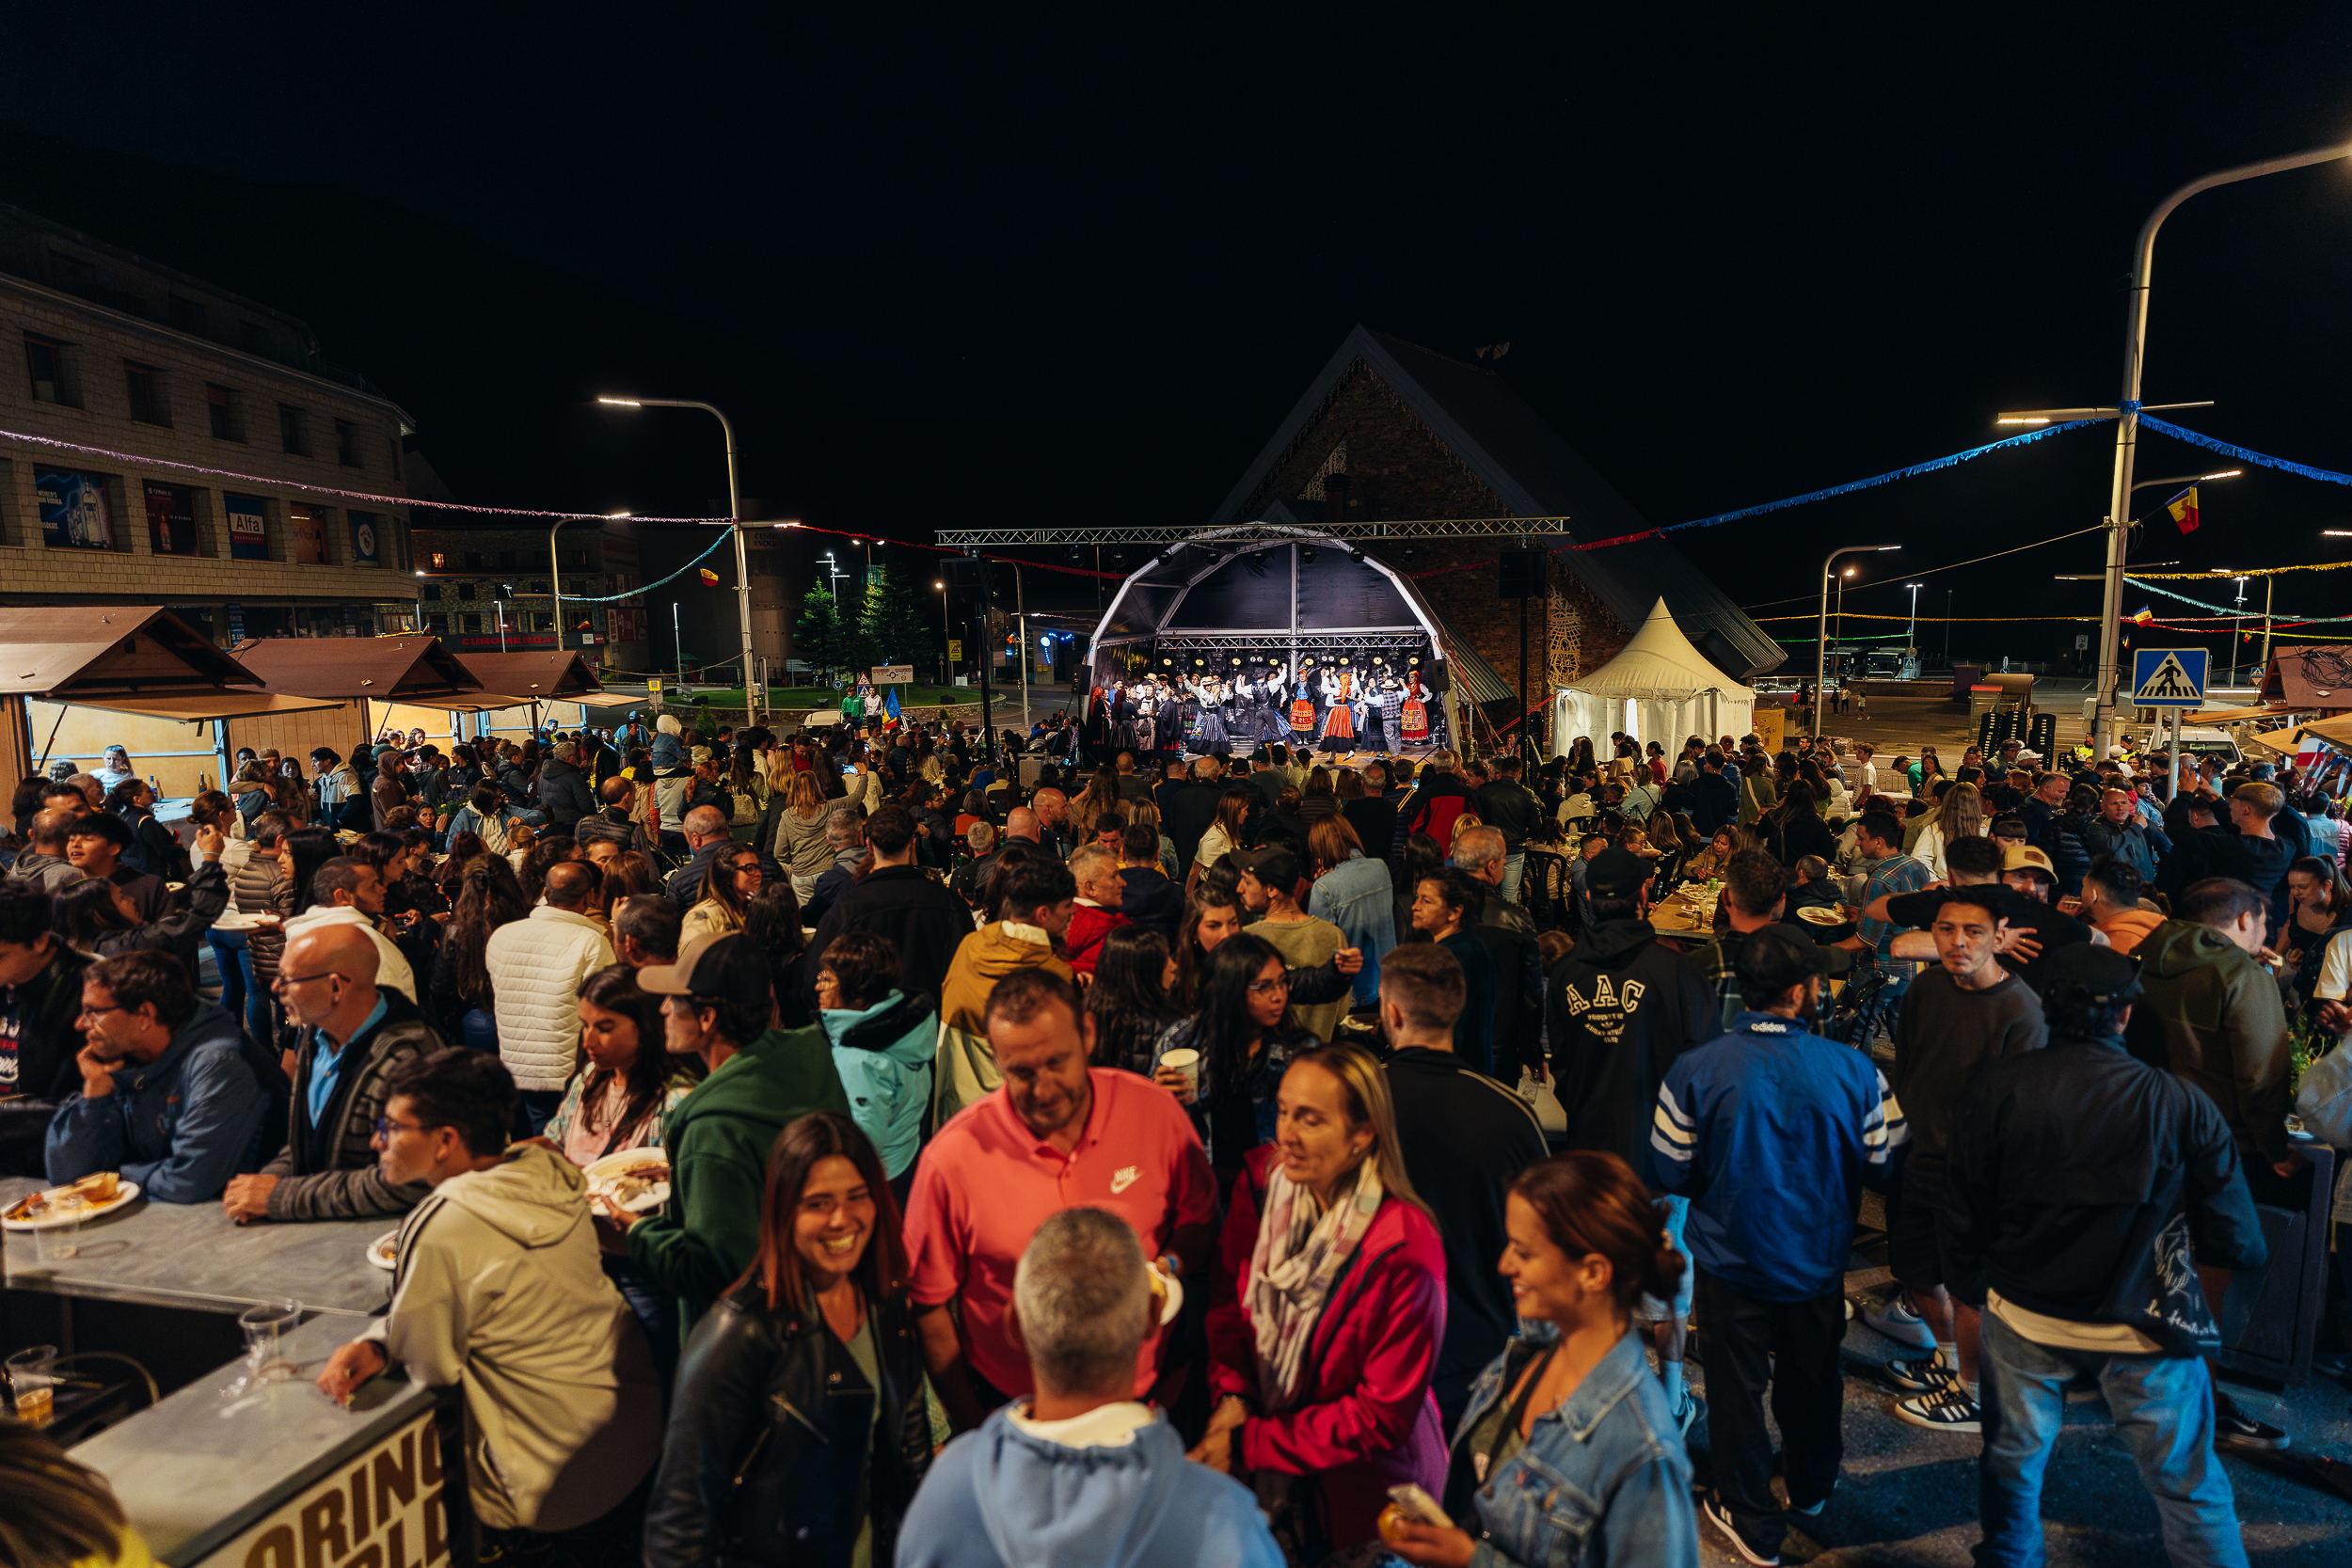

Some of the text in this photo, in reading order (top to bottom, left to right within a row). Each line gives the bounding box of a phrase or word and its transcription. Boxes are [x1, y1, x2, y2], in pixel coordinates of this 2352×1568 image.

[236, 515, 260, 532] Alfa
[461, 636, 558, 646] EUROMERCAT
[1565, 974, 1646, 1017] AAC
[1750, 1021, 1787, 1033] adidas
